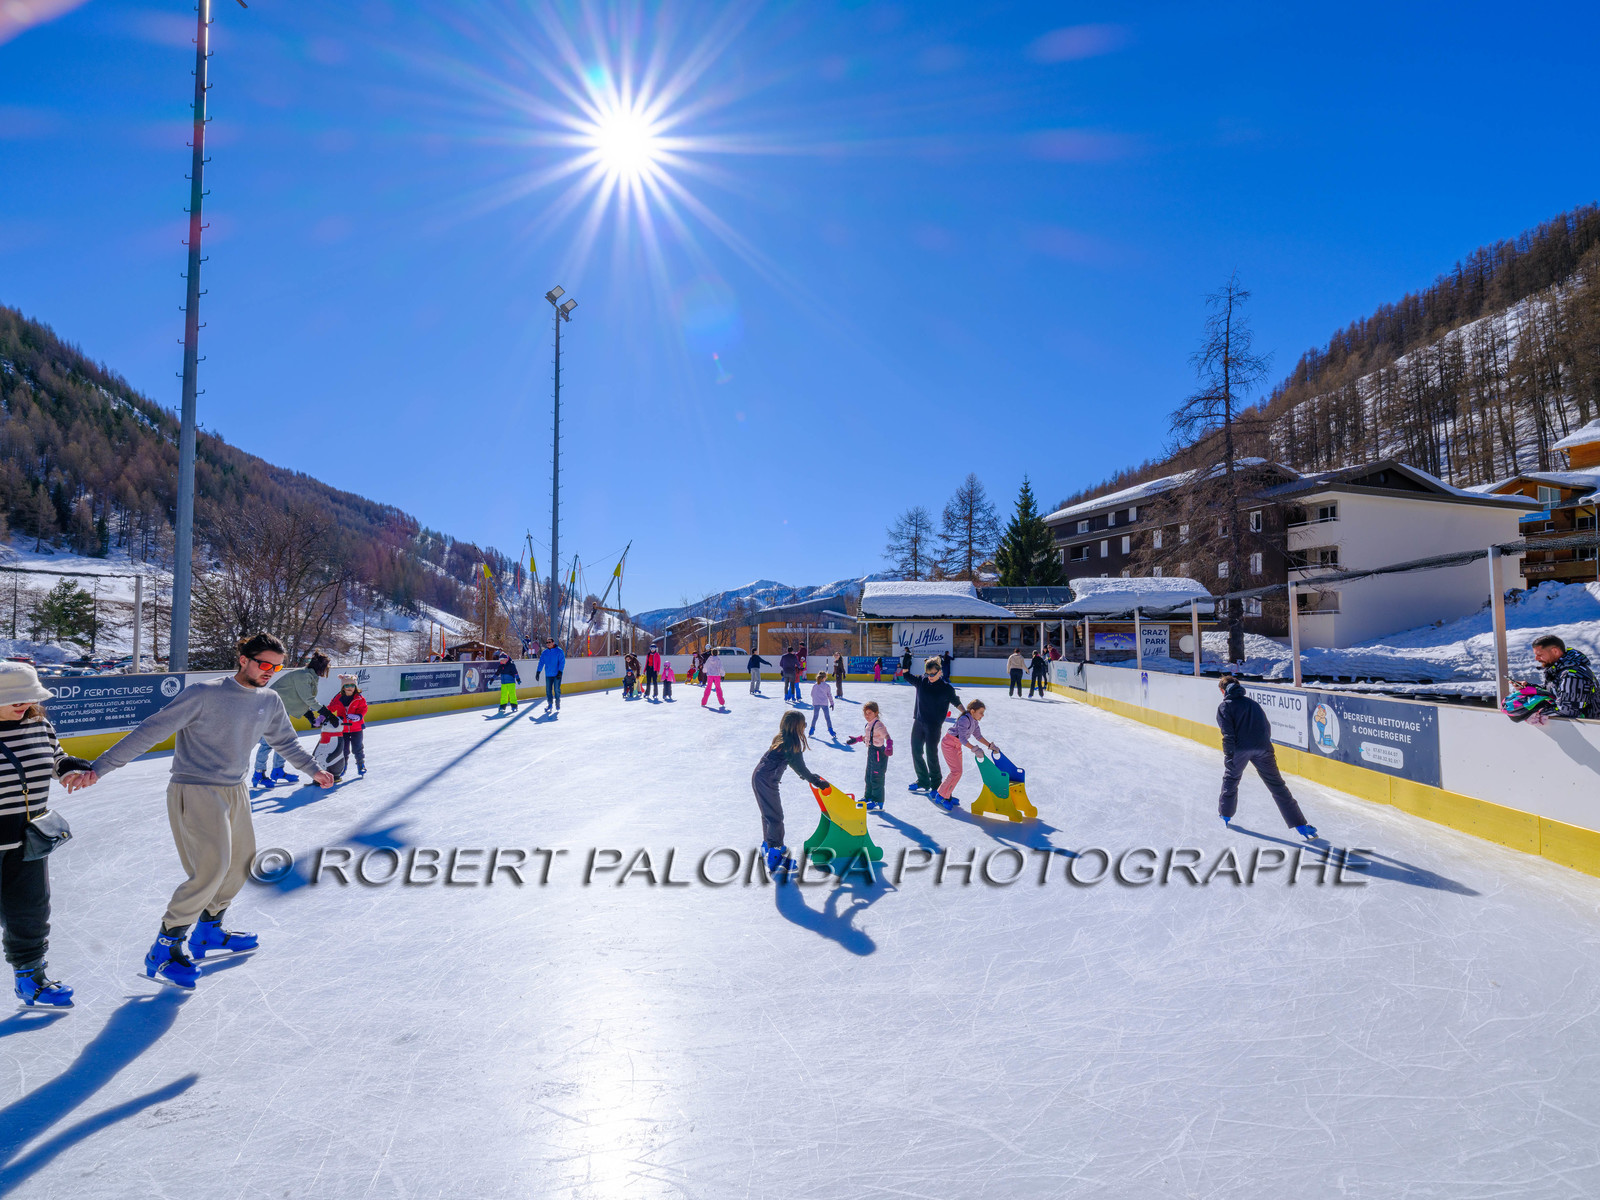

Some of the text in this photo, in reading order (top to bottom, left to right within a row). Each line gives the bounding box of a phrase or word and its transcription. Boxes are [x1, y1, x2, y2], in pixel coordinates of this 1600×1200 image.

[898, 627, 944, 647] Val d'Allos
[435, 672, 457, 680] publicitaires
[47, 685, 81, 698] ADP
[84, 685, 154, 697] FERMETURES
[84, 700, 125, 709] INSTALLATEUR
[1278, 696, 1302, 711] AUTO
[60, 707, 105, 717] MENUISERIE
[1343, 711, 1421, 732] DECREVEL NETTOYAGE
[1352, 725, 1412, 744] & CONCIERGERIE
